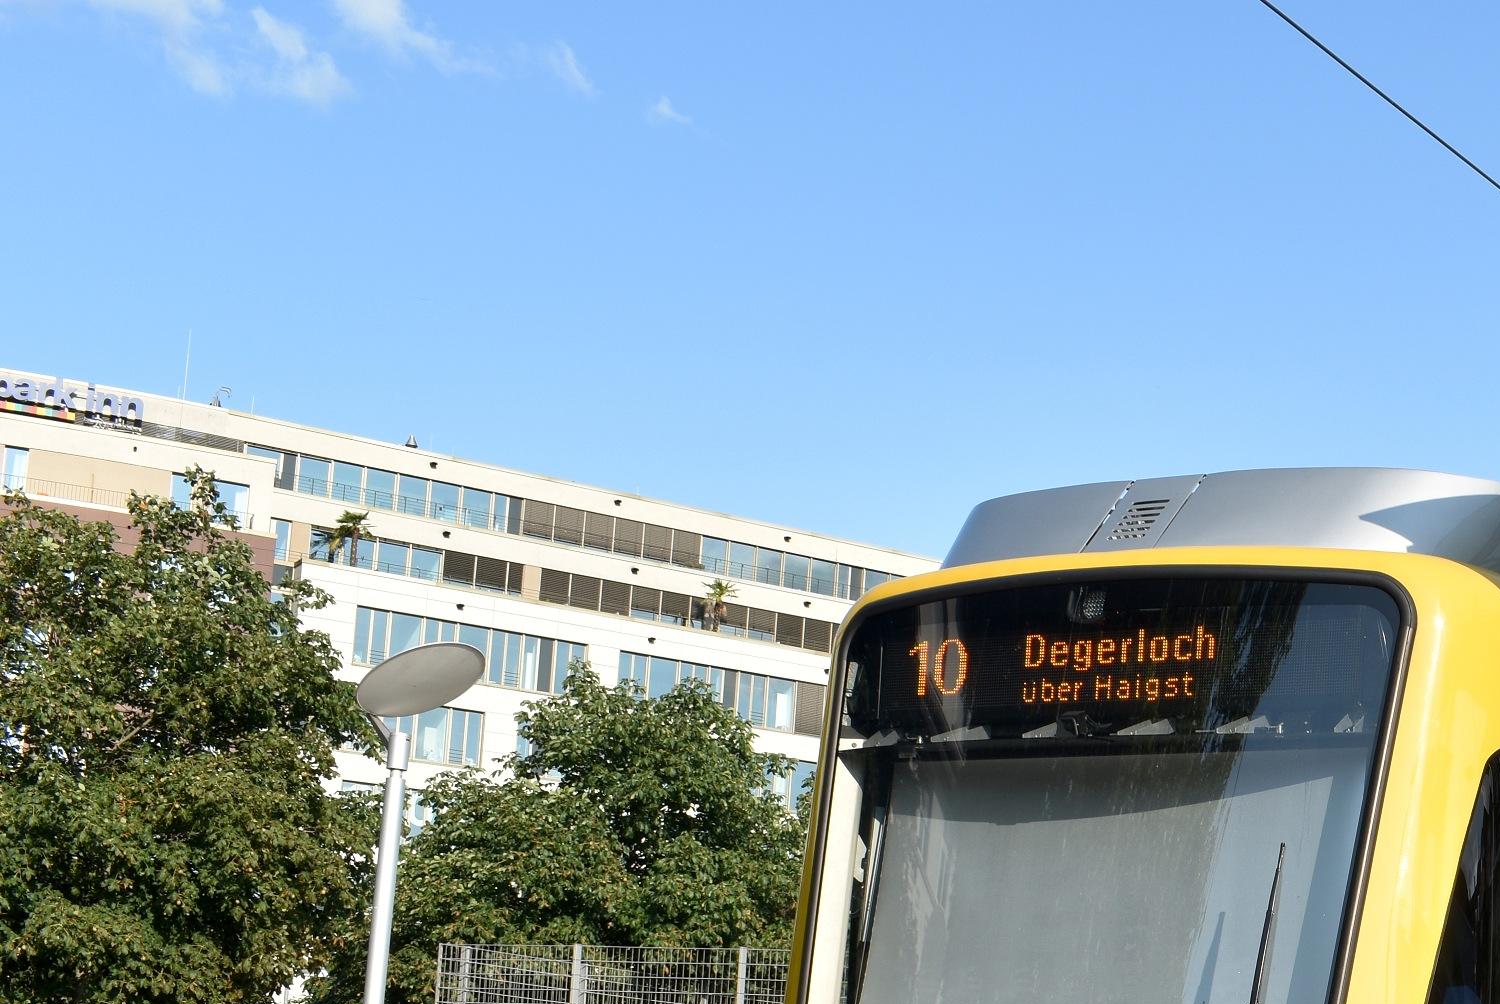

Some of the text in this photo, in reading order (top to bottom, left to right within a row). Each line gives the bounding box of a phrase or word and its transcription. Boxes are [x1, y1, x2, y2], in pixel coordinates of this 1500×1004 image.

[87, 382, 144, 421] inn
[908, 639, 968, 696] 10
[1024, 625, 1216, 671] Degerloch
[1023, 672, 1194, 703] über Haigst
